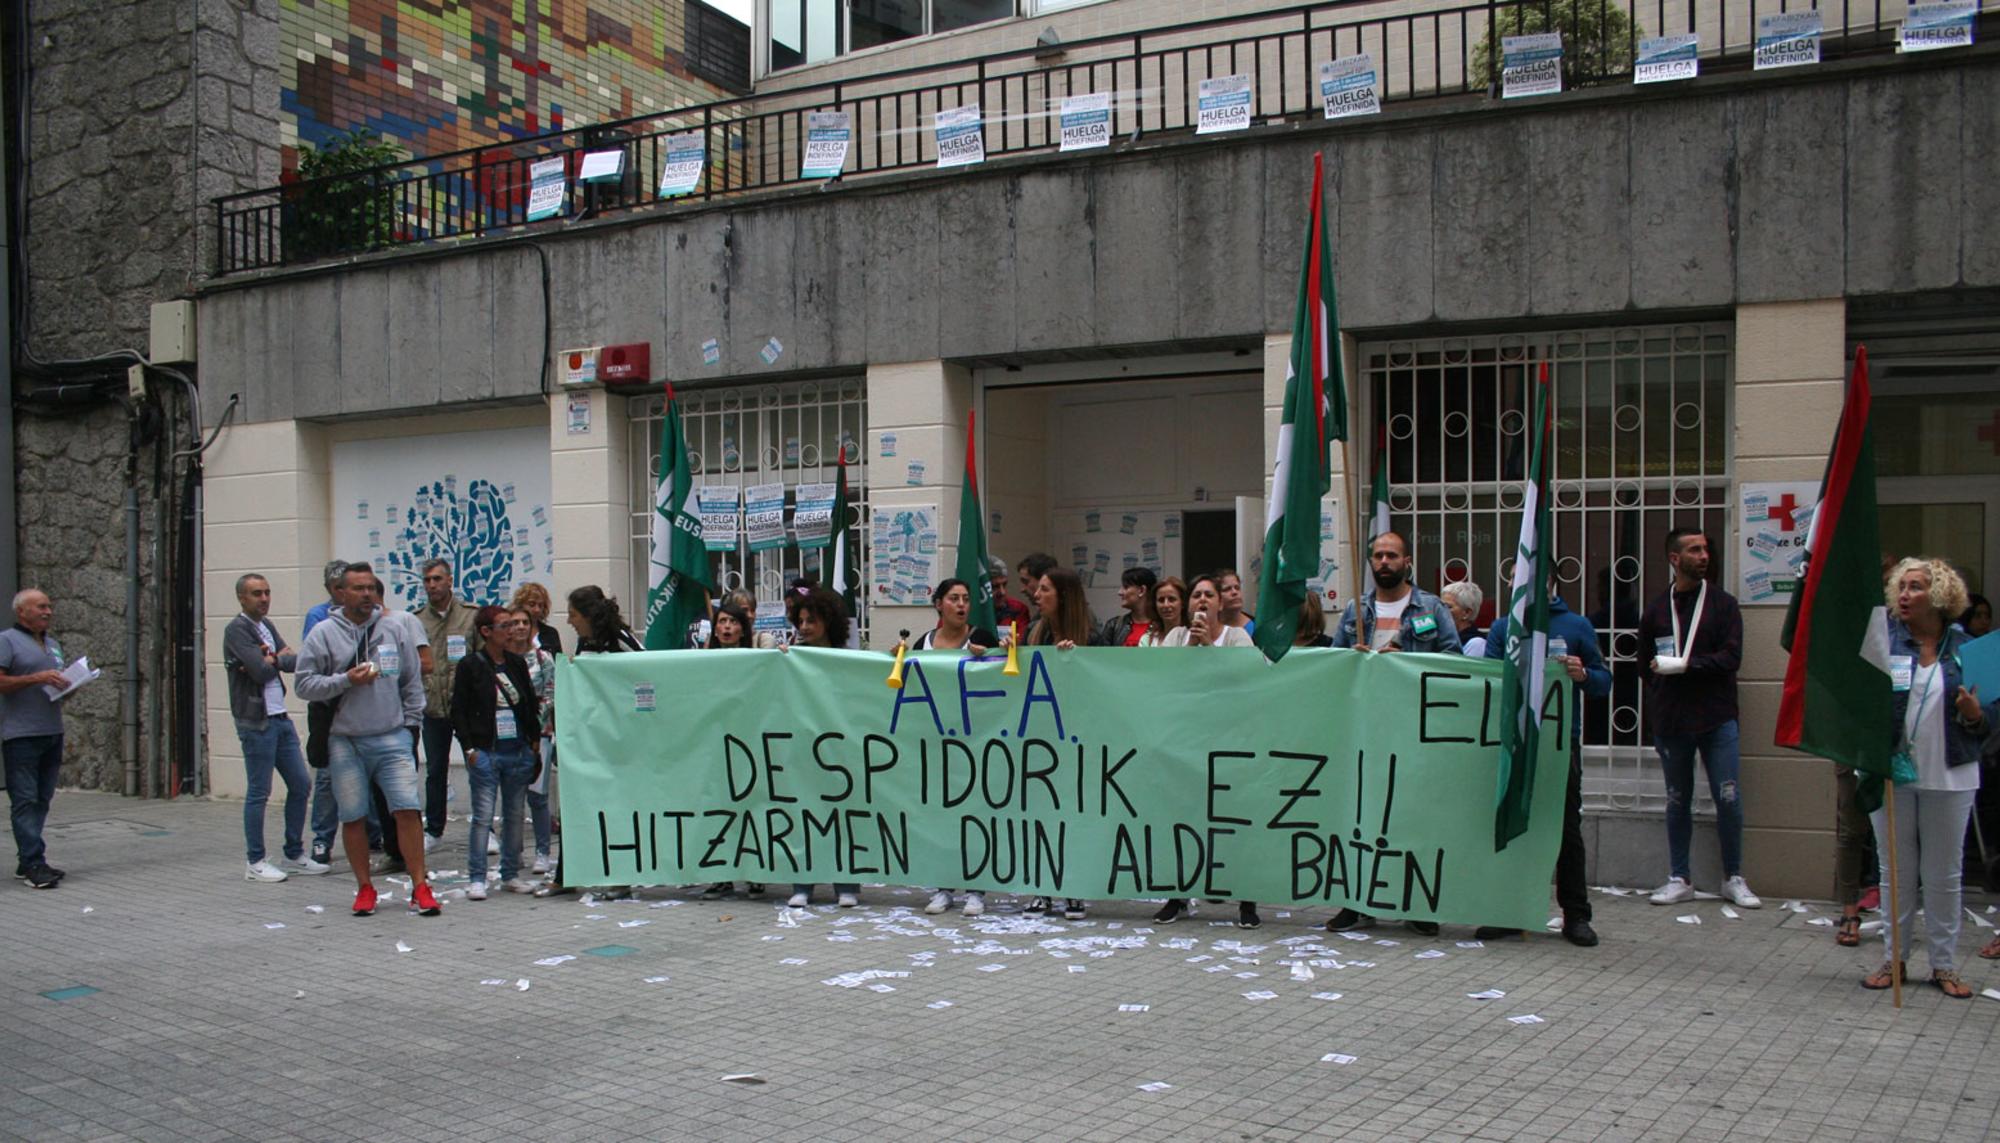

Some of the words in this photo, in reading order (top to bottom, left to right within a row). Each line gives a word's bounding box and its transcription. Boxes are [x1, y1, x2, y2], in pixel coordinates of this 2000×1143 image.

[1904, 26, 1966, 40] HUELGA
[1757, 51, 1815, 66] INDEFINIDA
[1638, 61, 1693, 76] HUELGA
[1506, 70, 1557, 85] INDEFINIDA
[1326, 87, 1375, 107] HUELGA
[1201, 106, 1247, 121] HUELGA
[1327, 98, 1377, 116] INDEFINIDA
[1200, 116, 1247, 129] INDEFINIDA
[1063, 123, 1106, 138] HUELGA
[809, 141, 845, 151] HUELGA
[939, 134, 980, 150] HUELGA
[1063, 133, 1106, 147] INDEFINIDA
[807, 150, 843, 160] INDEFINIDA
[940, 145, 981, 160] INDEFINIDA
[667, 161, 700, 174] HUELGA
[532, 184, 562, 198] HUELGA
[701, 514, 735, 524] HUELGA
[748, 511, 780, 523] HUELGA
[796, 512, 829, 522] HUELGA
[1420, 671, 1563, 752] ELA
[724, 732, 1138, 819] DESPIDORIK
[598, 808, 909, 877] HITZARMEN
[961, 815, 1065, 891] DUIN
[1108, 822, 1237, 897] ALDE
[1291, 831, 1445, 913] BATEN
